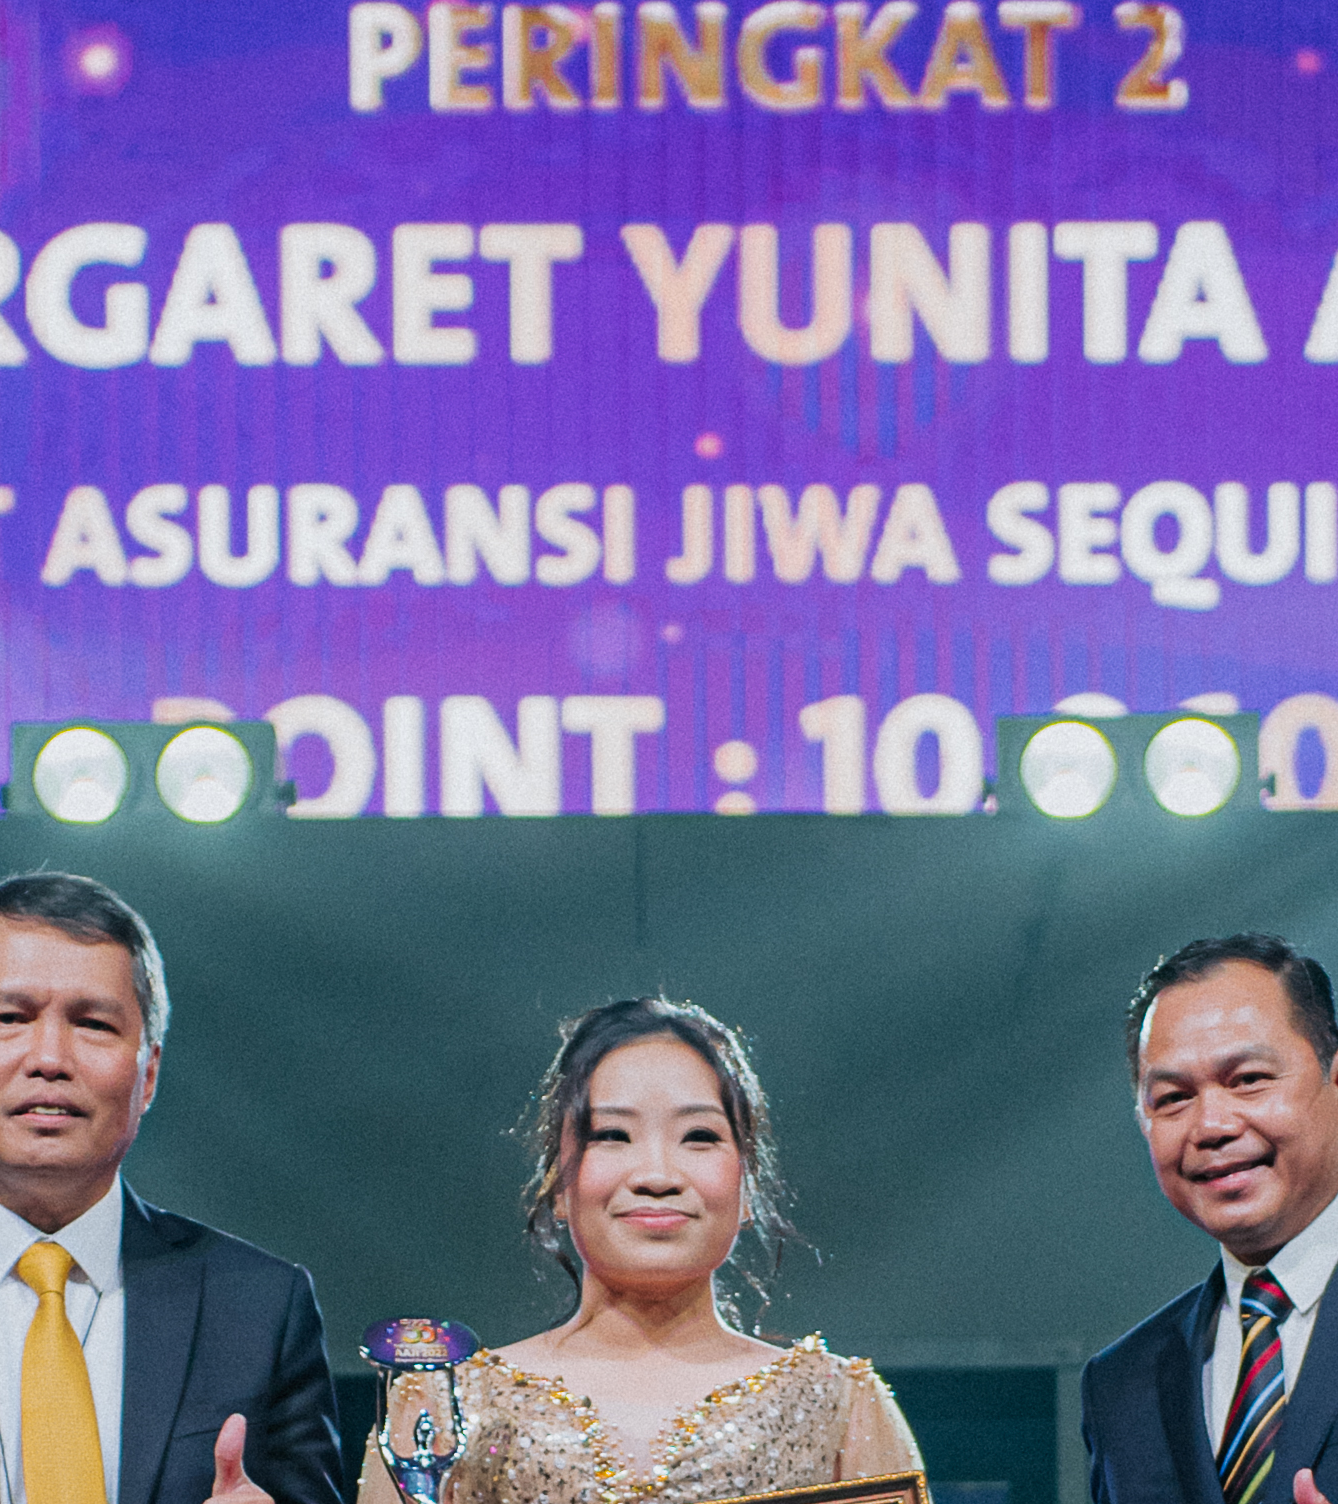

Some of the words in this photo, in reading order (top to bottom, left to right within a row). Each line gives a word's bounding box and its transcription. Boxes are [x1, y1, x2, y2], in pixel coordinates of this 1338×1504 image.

[347, 0, 1078, 114] PERINGKAT
[1113, 0, 1191, 112] 2
[622, 221, 1269, 366] YUNITA
[41, 484, 636, 588] ASURANSI
[665, 484, 961, 585] JIWA
[151, 695, 667, 820] OINT
